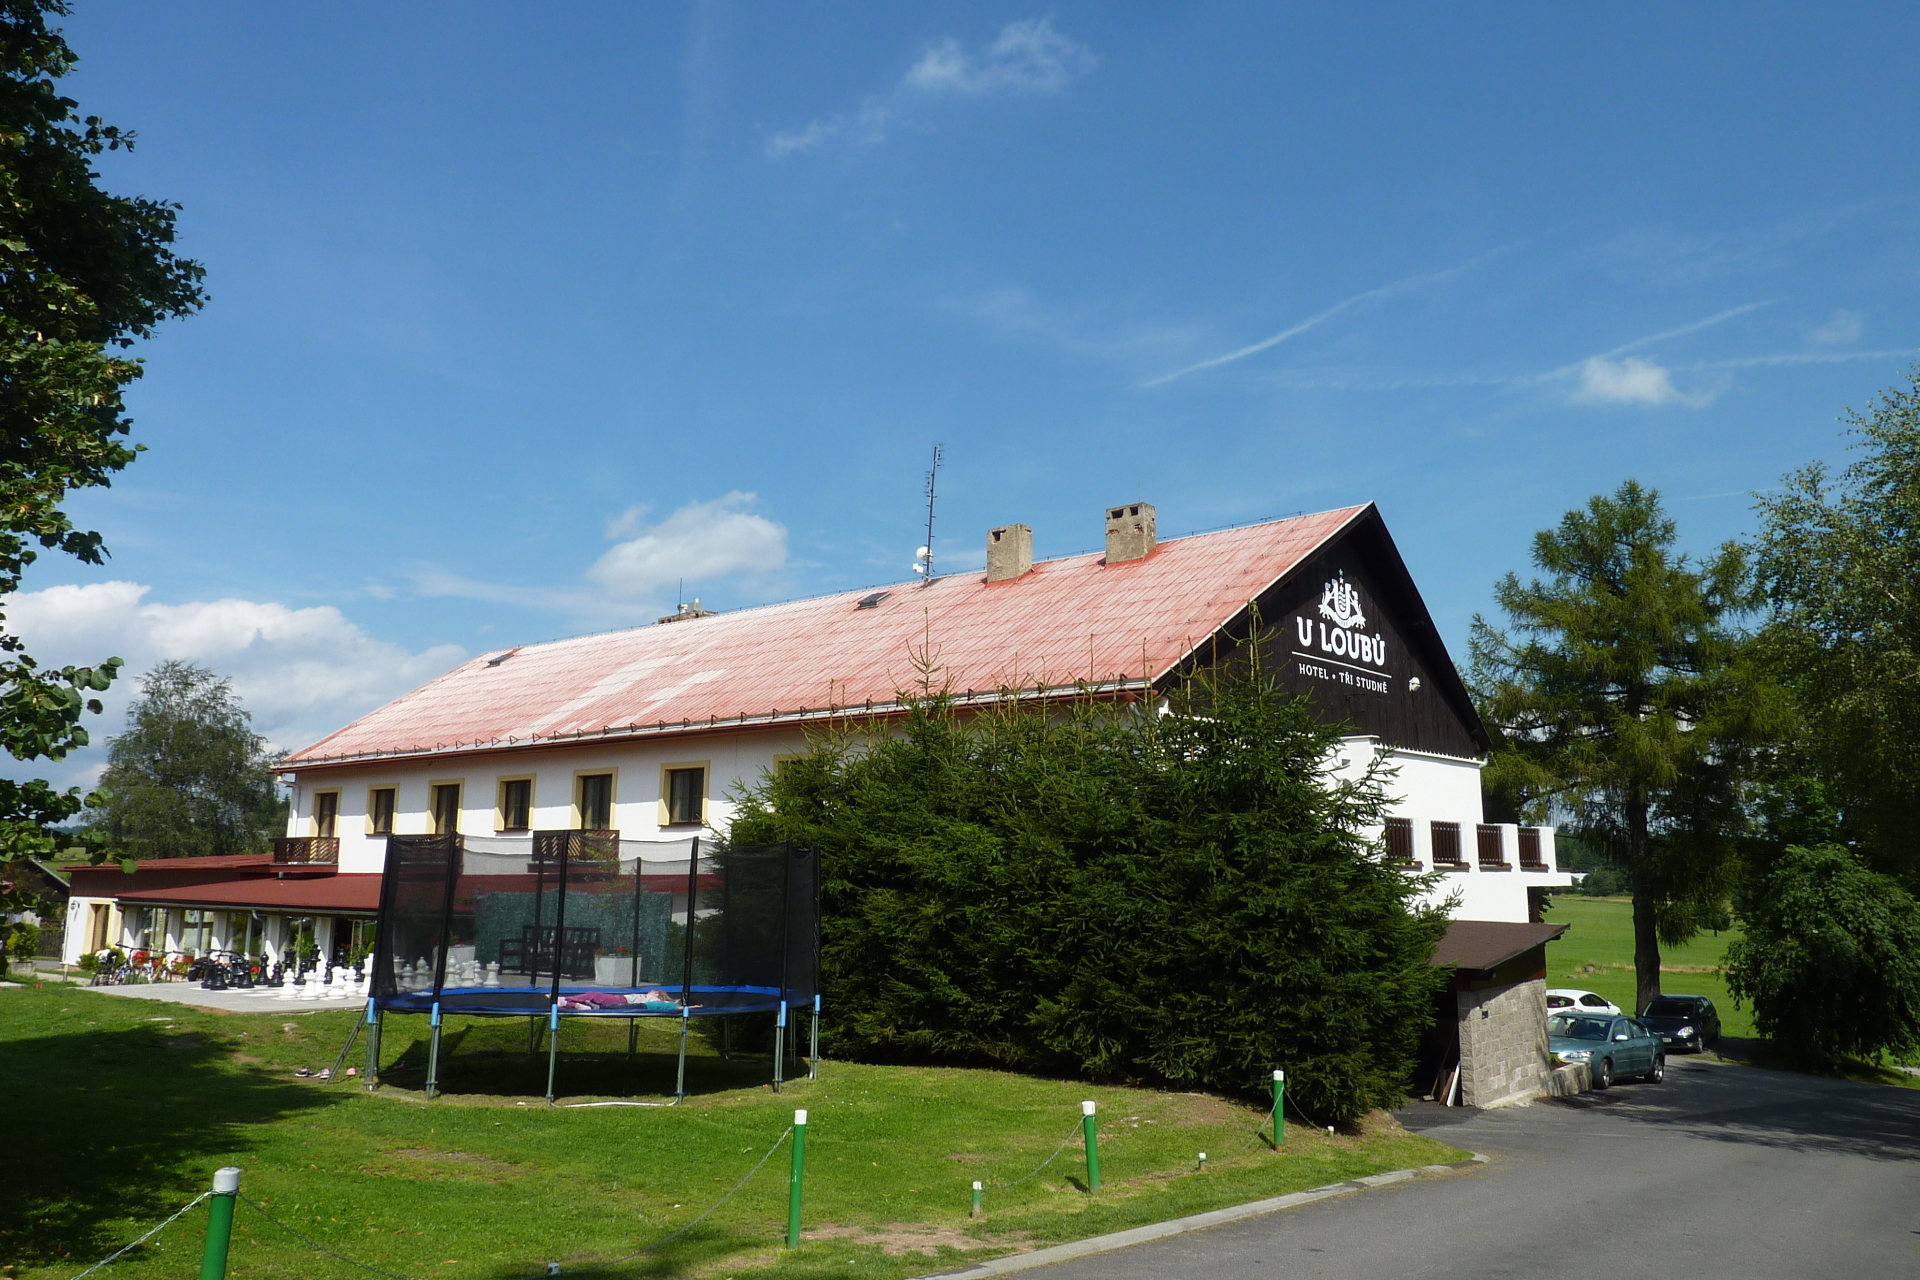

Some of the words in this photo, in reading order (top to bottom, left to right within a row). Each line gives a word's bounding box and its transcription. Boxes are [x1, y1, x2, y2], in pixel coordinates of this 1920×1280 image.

[1297, 616, 1312, 646] U
[1320, 623, 1385, 666] LOUBŮ
[1299, 663, 1329, 680] HOTEL
[1339, 671, 1354, 685] TŘI
